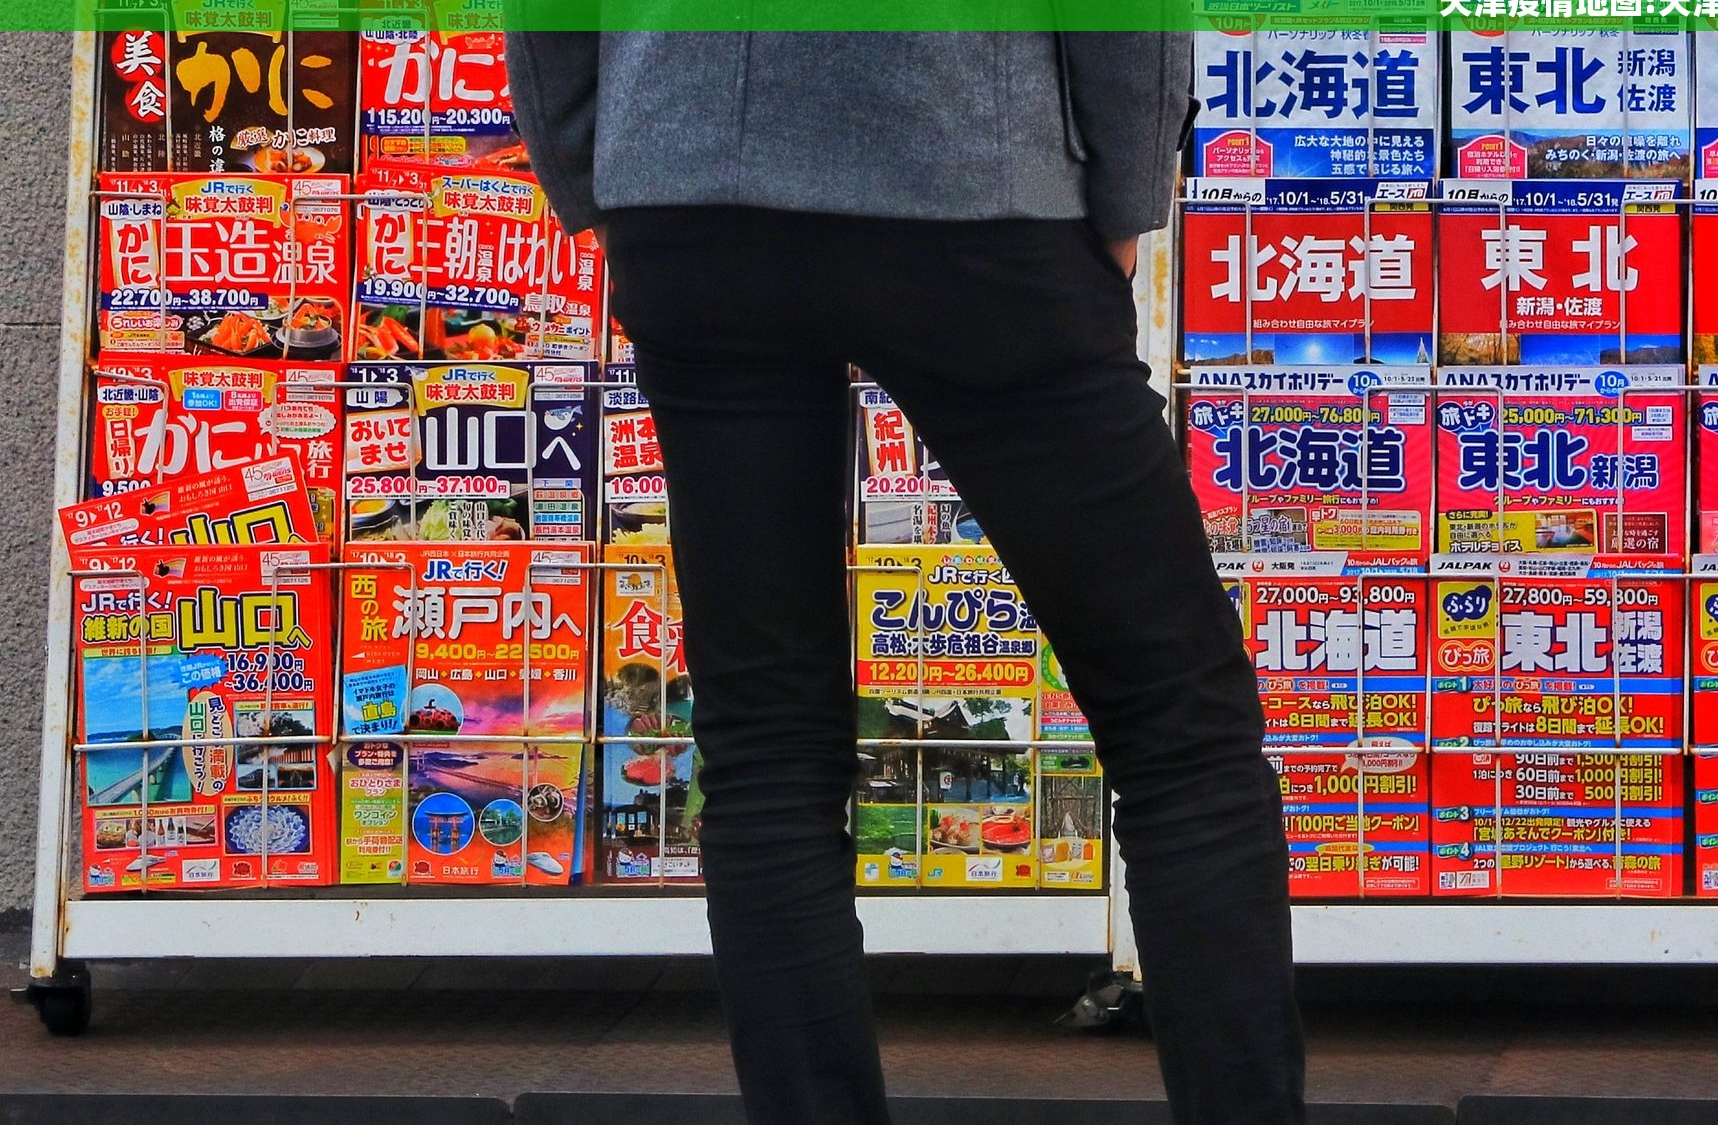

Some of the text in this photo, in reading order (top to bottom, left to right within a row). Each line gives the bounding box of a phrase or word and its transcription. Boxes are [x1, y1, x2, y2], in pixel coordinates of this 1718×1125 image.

[185, 10, 273, 29] 味覚太鼓判
[116, 33, 165, 119] 美食
[175, 42, 334, 122] かに
[1206, 49, 1421, 120] 北海道
[1462, 47, 1607, 116] 東北
[1617, 48, 1676, 78] 新潟
[1617, 83, 1676, 114] 佐渡
[184, 195, 274, 214] 味覚太鼓判
[441, 176, 535, 196] スーパーはくとで行く
[163, 218, 338, 285] 玉造温泉
[1210, 234, 1417, 303] 北海道
[1480, 225, 1640, 293] 東北
[1515, 297, 1603, 317] 新潟・佐渡
[426, 383, 515, 401] 味覚太鼓判
[426, 407, 581, 471] 山口へ
[1213, 428, 1404, 492] 北海道
[1460, 429, 1586, 490] 東北
[83, 611, 174, 642] 維新の国
[391, 586, 582, 640] 瀬戸内へ
[1257, 610, 1419, 673] 北海道
